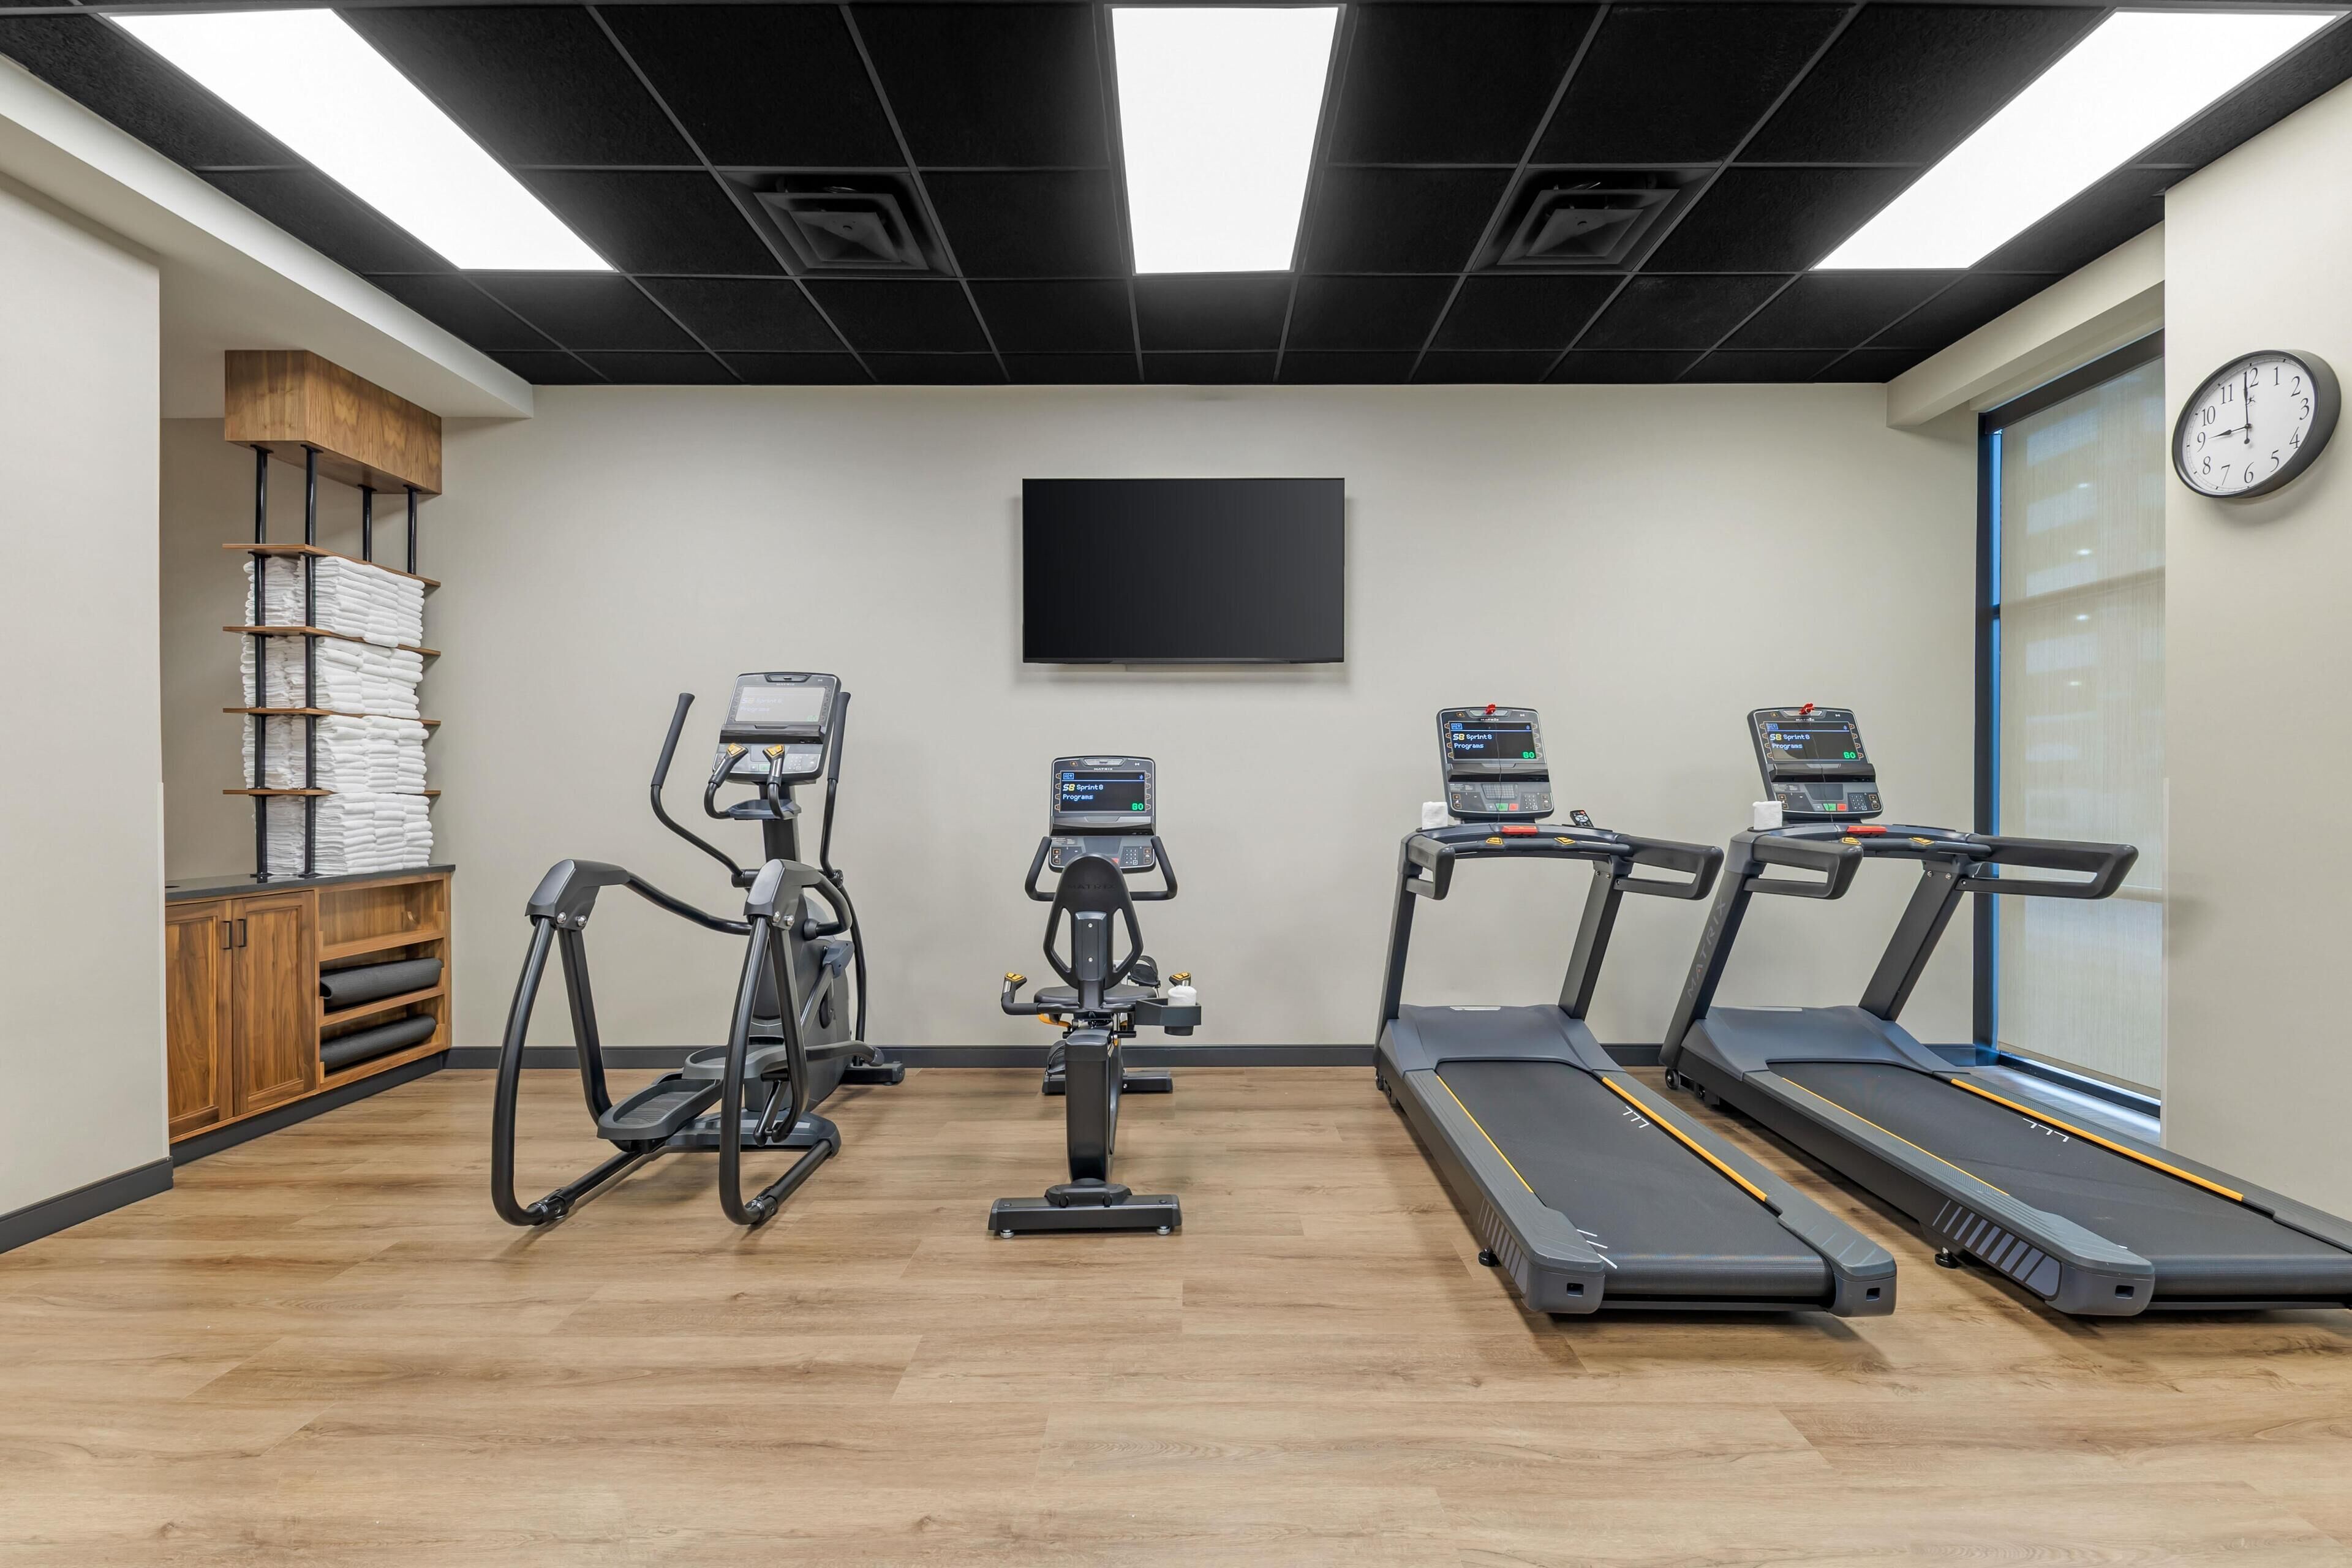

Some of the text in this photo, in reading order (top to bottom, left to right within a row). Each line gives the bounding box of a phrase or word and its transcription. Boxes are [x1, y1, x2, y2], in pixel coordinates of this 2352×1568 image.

[2274, 366, 2280, 386] 1
[2290, 376, 2301, 397] 2
[2221, 383, 2234, 404] 11
[2201, 406, 2215, 426] 10
[2299, 398, 2310, 420] 3
[2197, 432, 2206, 453] 9
[2289, 427, 2300, 449] 4
[2203, 456, 2211, 475] 8
[2270, 450, 2279, 472] 5
[2221, 464, 2231, 485] 7
[2244, 462, 2254, 484] 6
[1687, 897, 1725, 998] MATRIX
